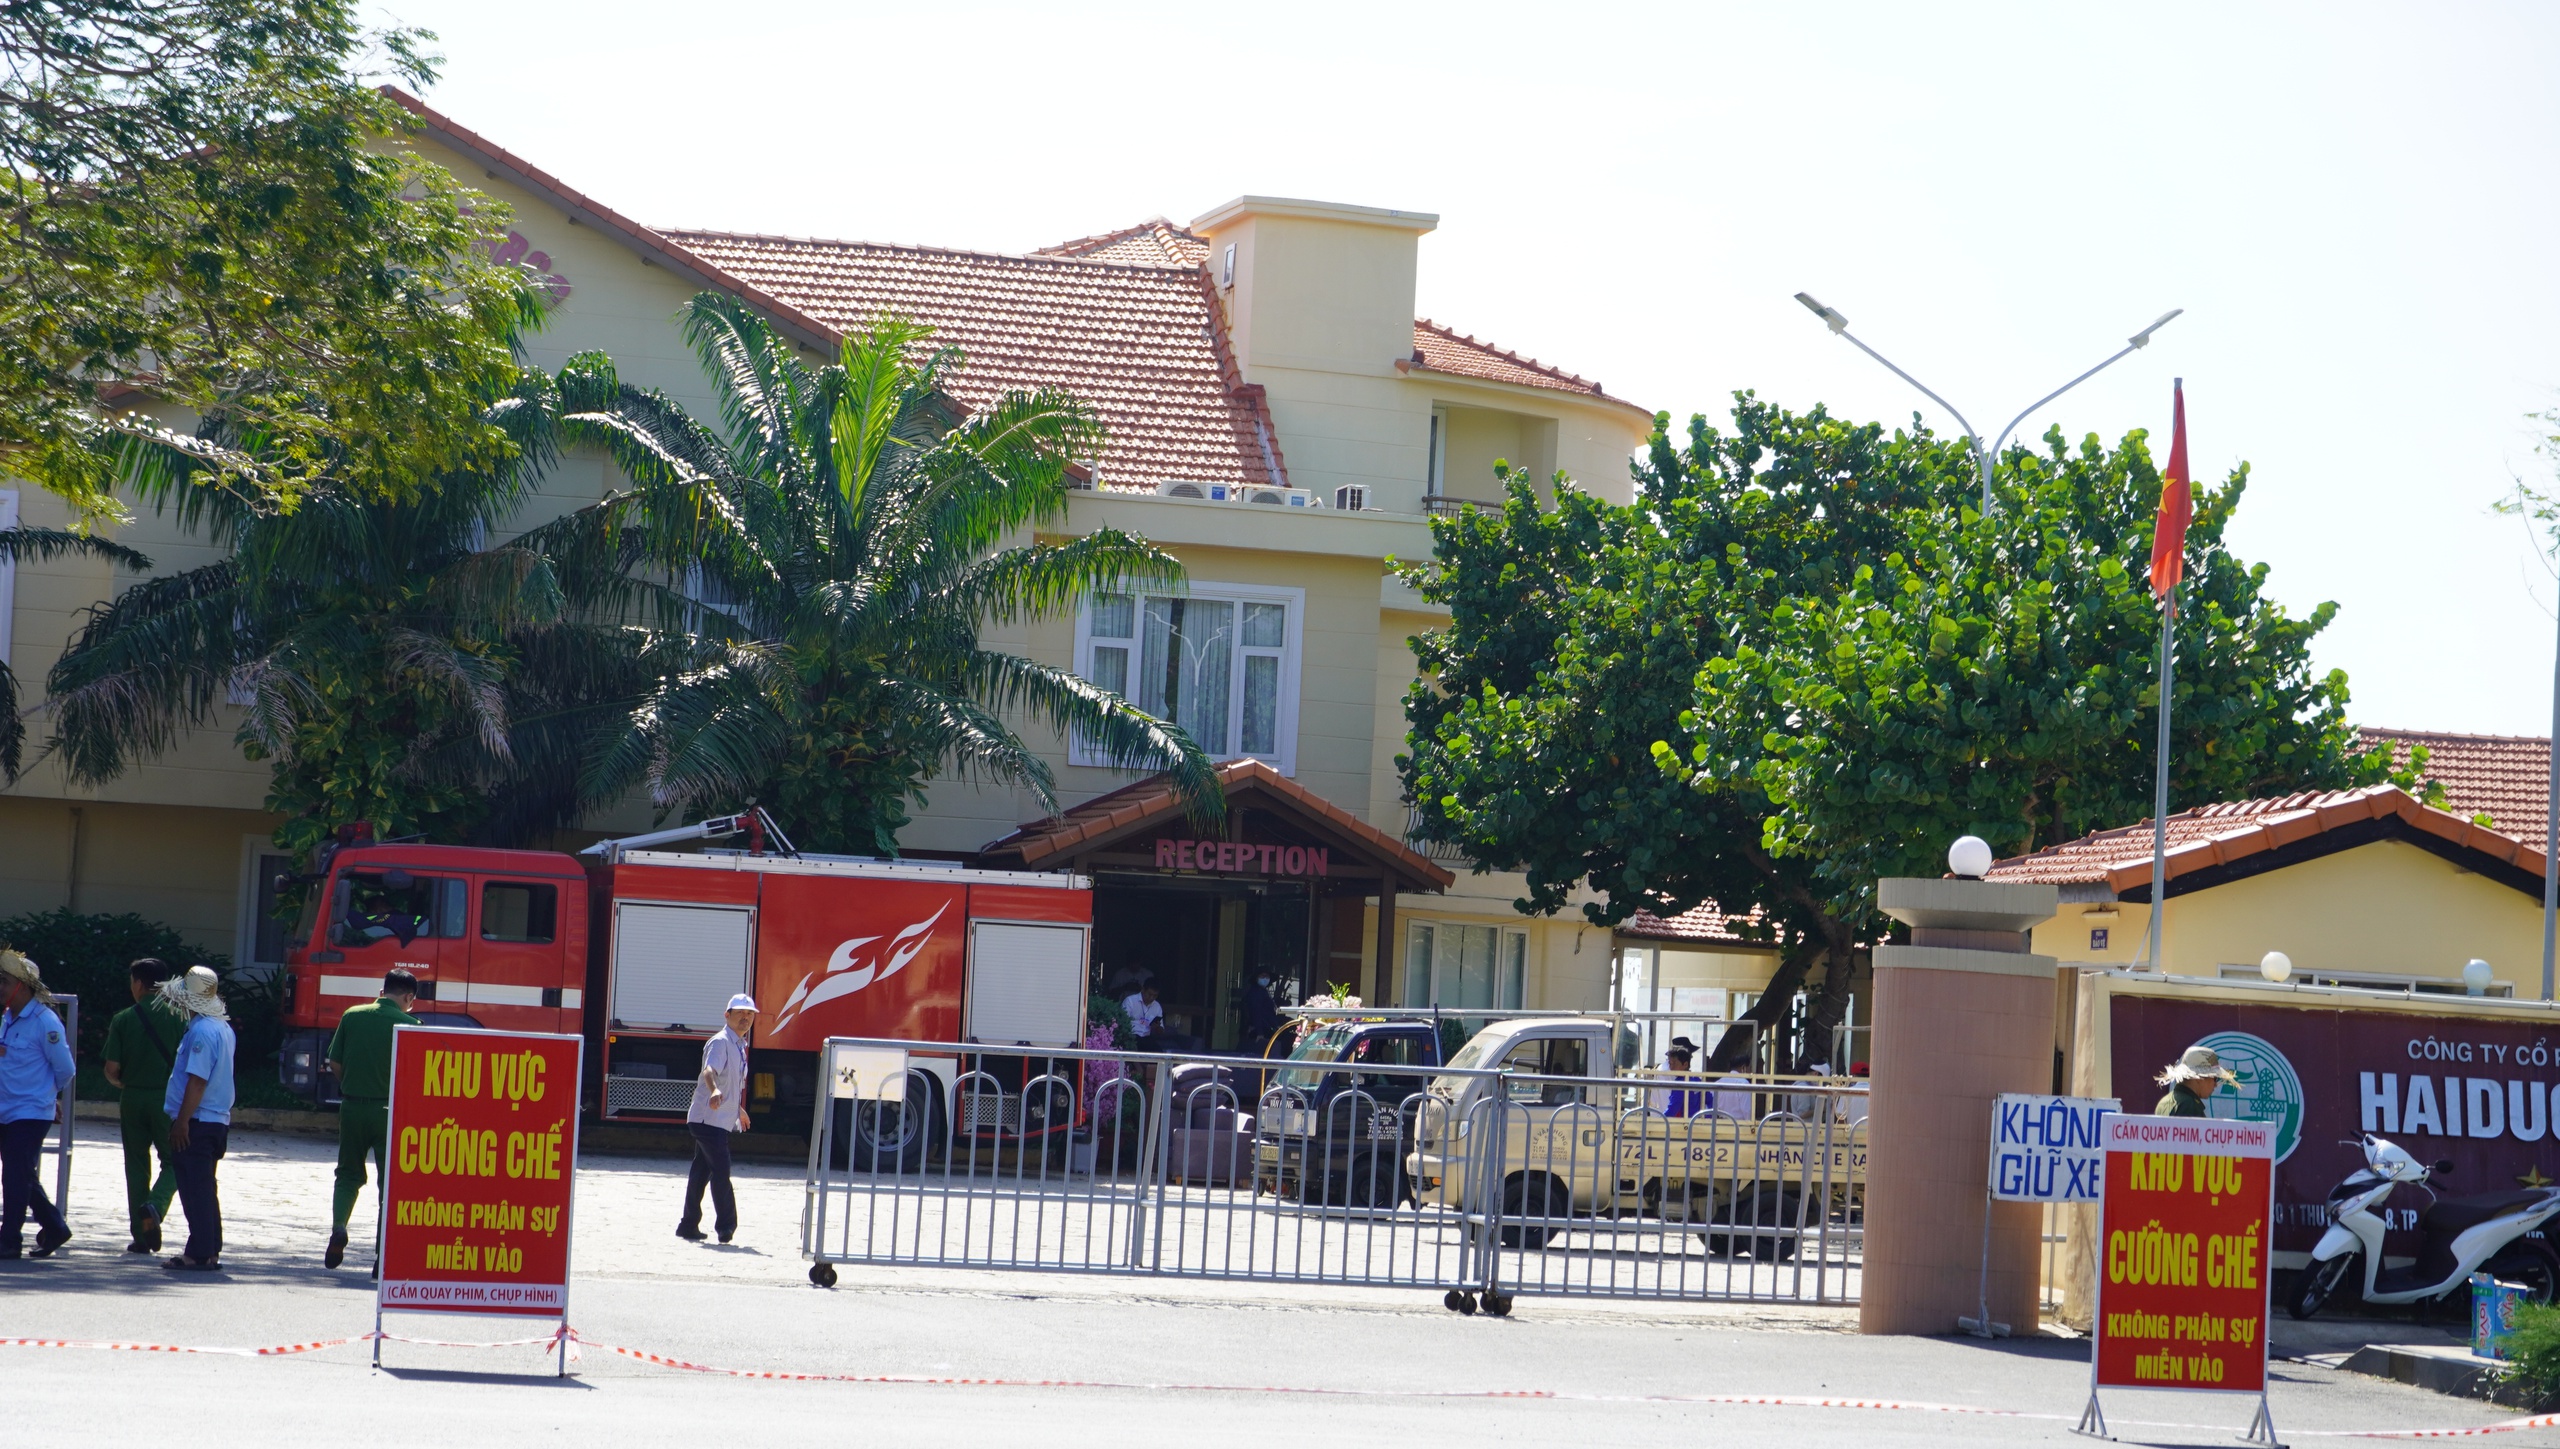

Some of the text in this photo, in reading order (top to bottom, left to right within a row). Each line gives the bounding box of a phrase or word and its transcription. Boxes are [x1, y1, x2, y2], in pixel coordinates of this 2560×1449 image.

[1155, 839, 1328, 876] RECEPTION
[2407, 1035, 2473, 1062] CÔNG
[2480, 1044, 2508, 1063] TY
[2516, 1037, 2548, 1066] CỔ
[423, 1050, 546, 1110] KHU VỰC
[2360, 1071, 2560, 1142] HAIDU
[399, 1117, 566, 1180] CƯỠNG CHẾ
[2112, 1120, 2266, 1148] (CẤM QUAY PHIM, CHỤP HÌNH)
[1681, 1147, 1728, 1162] 1892
[2130, 1152, 2184, 1193] KHU
[2064, 1158, 2100, 1198] XE
[397, 1197, 560, 1237] KHÔNG PHẬN SỰ
[426, 1237, 522, 1273] MIỄN VÀO
[2109, 1219, 2261, 1289] CƯỠNG CHẾ
[388, 1281, 557, 1305] (CẤM QUAY PHIM, CHỤP HÌNH)
[2107, 1309, 2257, 1348] KHÔNG PHẬN SỰ
[2135, 1347, 2224, 1383] MIỄN VÀO
